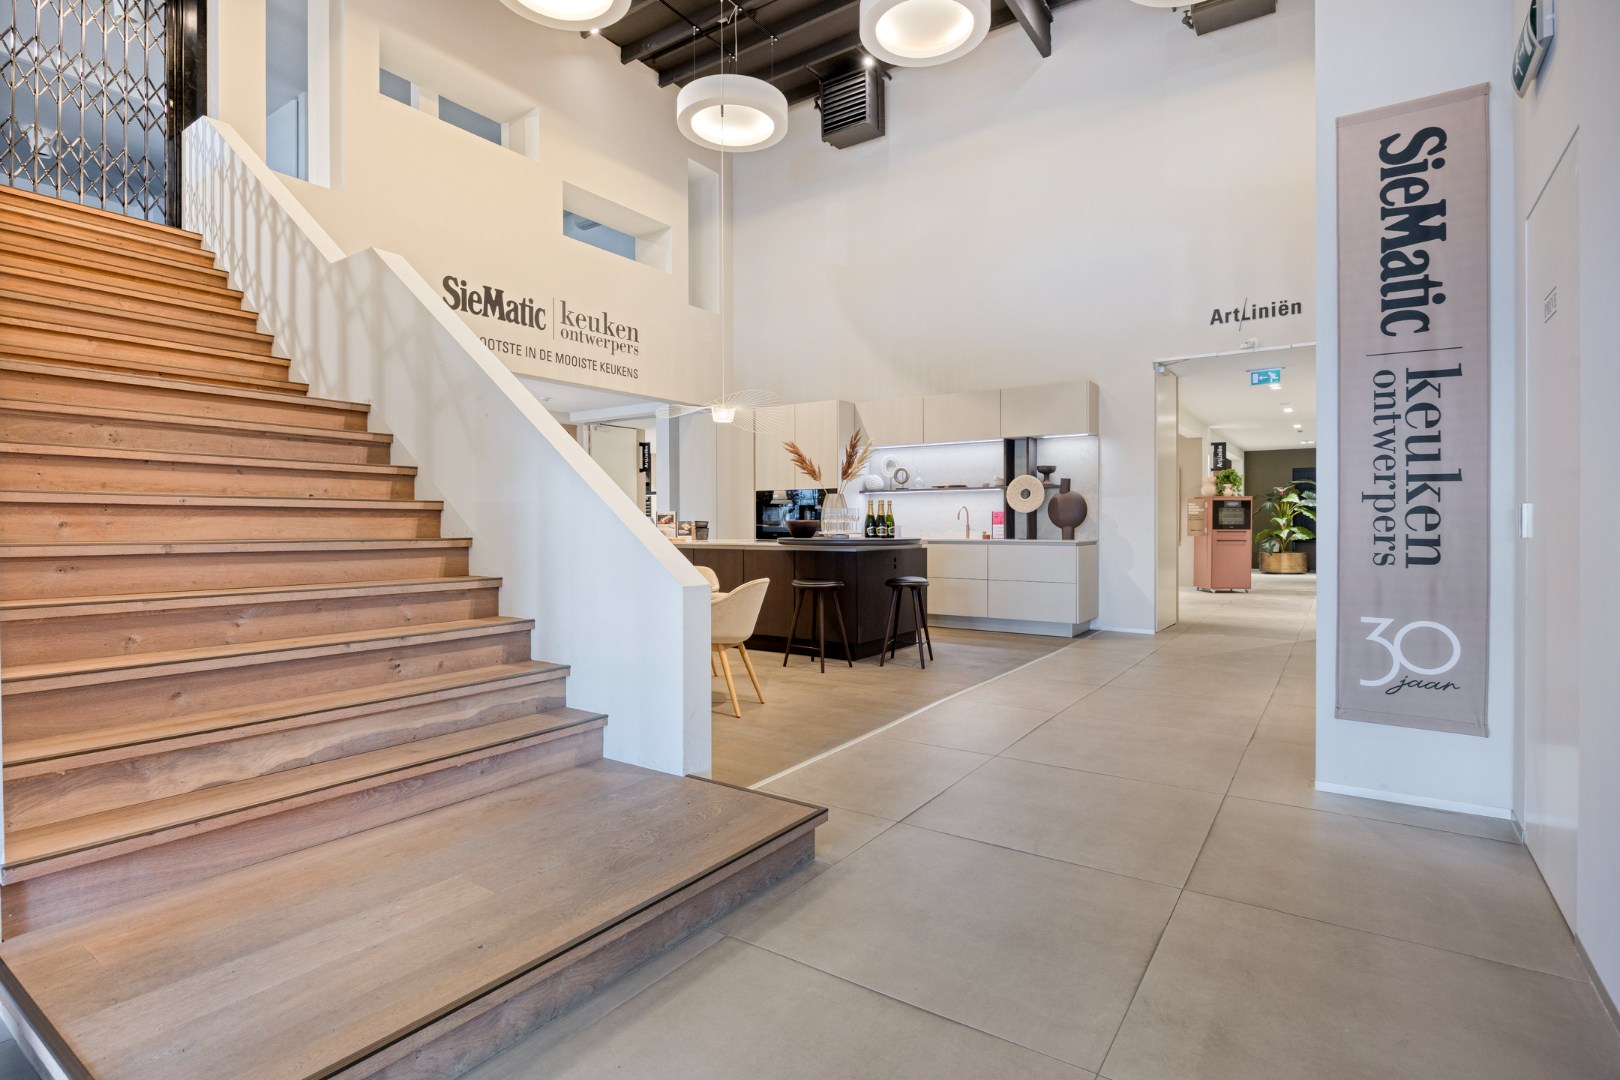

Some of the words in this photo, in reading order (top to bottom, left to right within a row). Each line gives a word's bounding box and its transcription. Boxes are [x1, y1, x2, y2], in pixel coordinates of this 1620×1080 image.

[1378, 126, 1448, 337] SieMatic
[442, 275, 547, 331] SieMatic
[560, 299, 640, 344] keuken
[1209, 297, 1302, 332] ArtLiniën
[525, 346, 537, 360] IN
[539, 348, 553, 363] DE
[555, 352, 598, 372] MOOISTE
[599, 361, 640, 380] KEUKENS
[560, 326, 640, 356] ontwerpers
[1361, 369, 1401, 567] ontwerpers
[1404, 363, 1463, 569] keuken
[1359, 616, 1462, 687] 30
